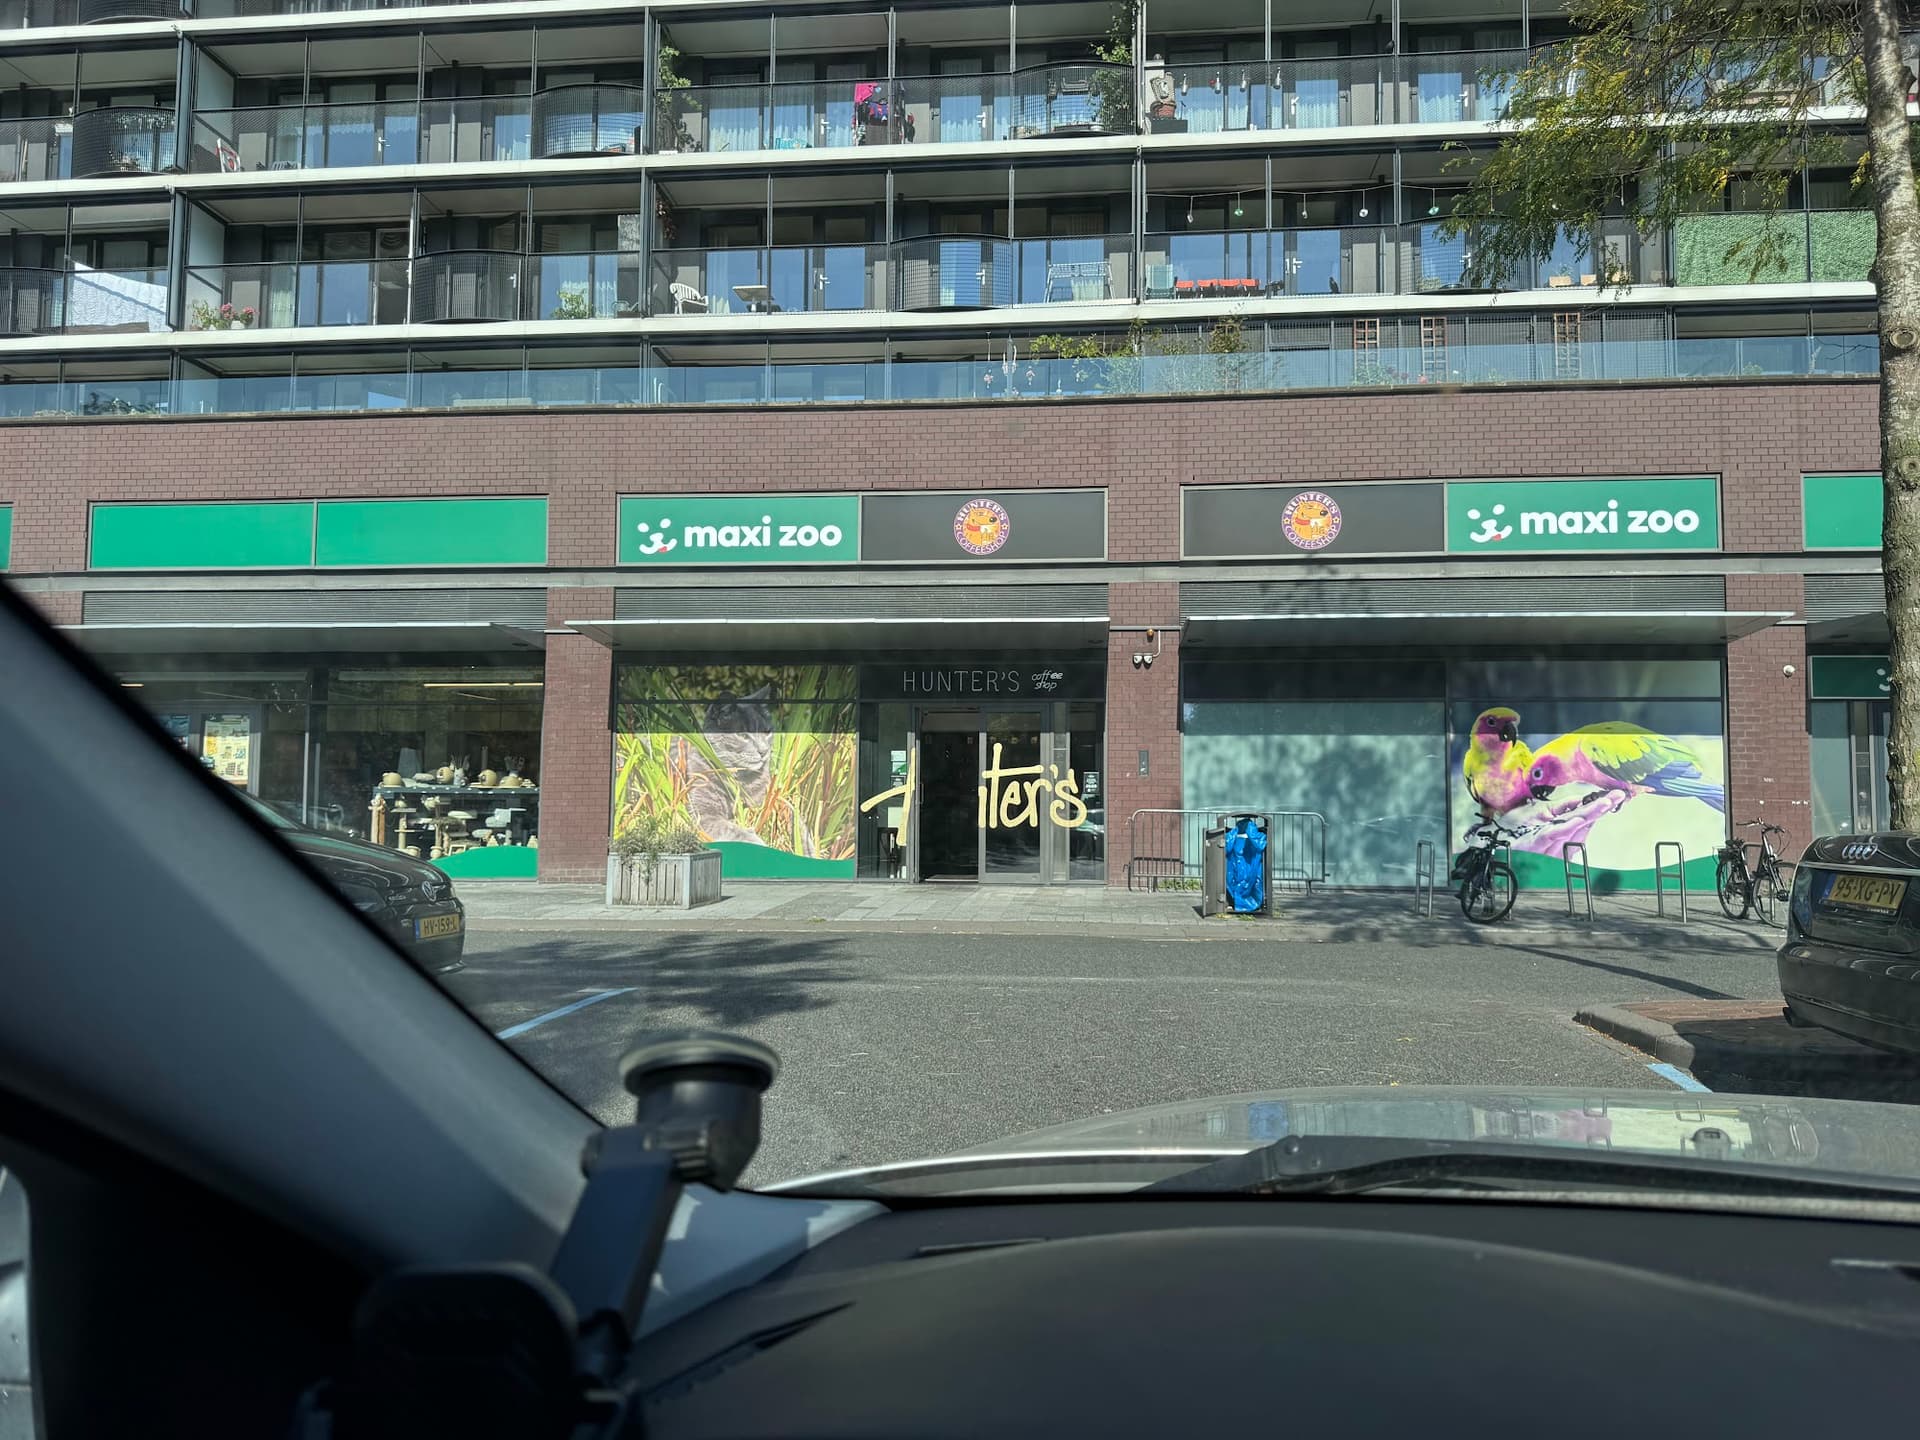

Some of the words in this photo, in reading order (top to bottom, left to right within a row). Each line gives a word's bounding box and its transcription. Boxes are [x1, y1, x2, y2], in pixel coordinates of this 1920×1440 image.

[957, 500, 1006, 521] HUNTER'S
[1285, 493, 1337, 515] HUNTER'S
[1520, 498, 1618, 535] maxi
[1627, 508, 1700, 535] zoo
[684, 514, 771, 548] maxi
[779, 524, 843, 548] zoo
[956, 531, 1006, 554] COFFEESHOP
[1285, 525, 1338, 548] COFFEESHOP
[903, 670, 1020, 692] HUNTER'S
[1031, 669, 1064, 681] coffee
[1034, 680, 1058, 692] shop
[1835, 877, 1901, 905] 95-XG-PV
